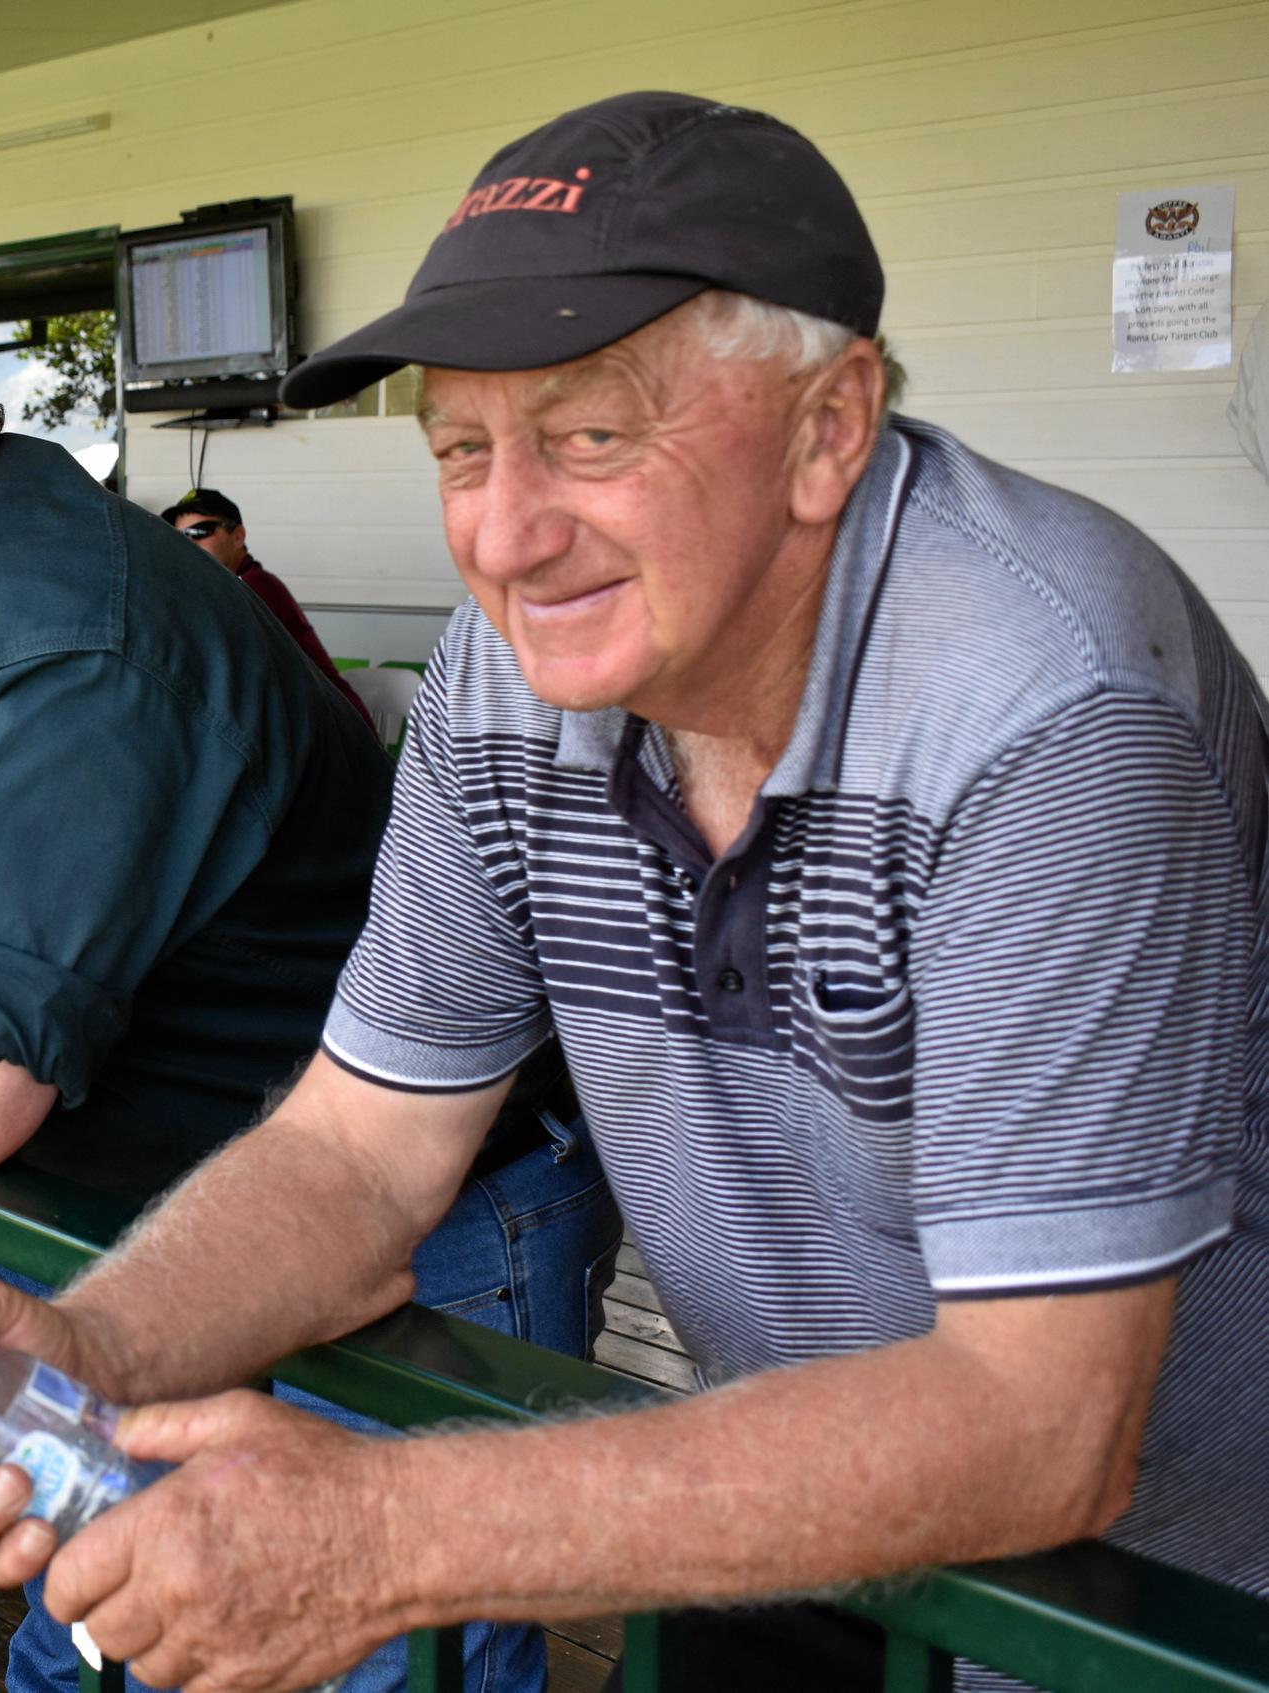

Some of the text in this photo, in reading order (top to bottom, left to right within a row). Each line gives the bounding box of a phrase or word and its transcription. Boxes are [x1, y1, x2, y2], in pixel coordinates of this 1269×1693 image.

[1140, 291, 1154, 300] the
[1188, 286, 1216, 297] Coffee
[1178, 302, 1196, 311] with
[1198, 300, 1208, 310] all
[1167, 318, 1189, 328] going
[1191, 316, 1201, 325] to
[1203, 316, 1217, 325] the
[1127, 329, 1219, 344] Roma Clay Target Club
